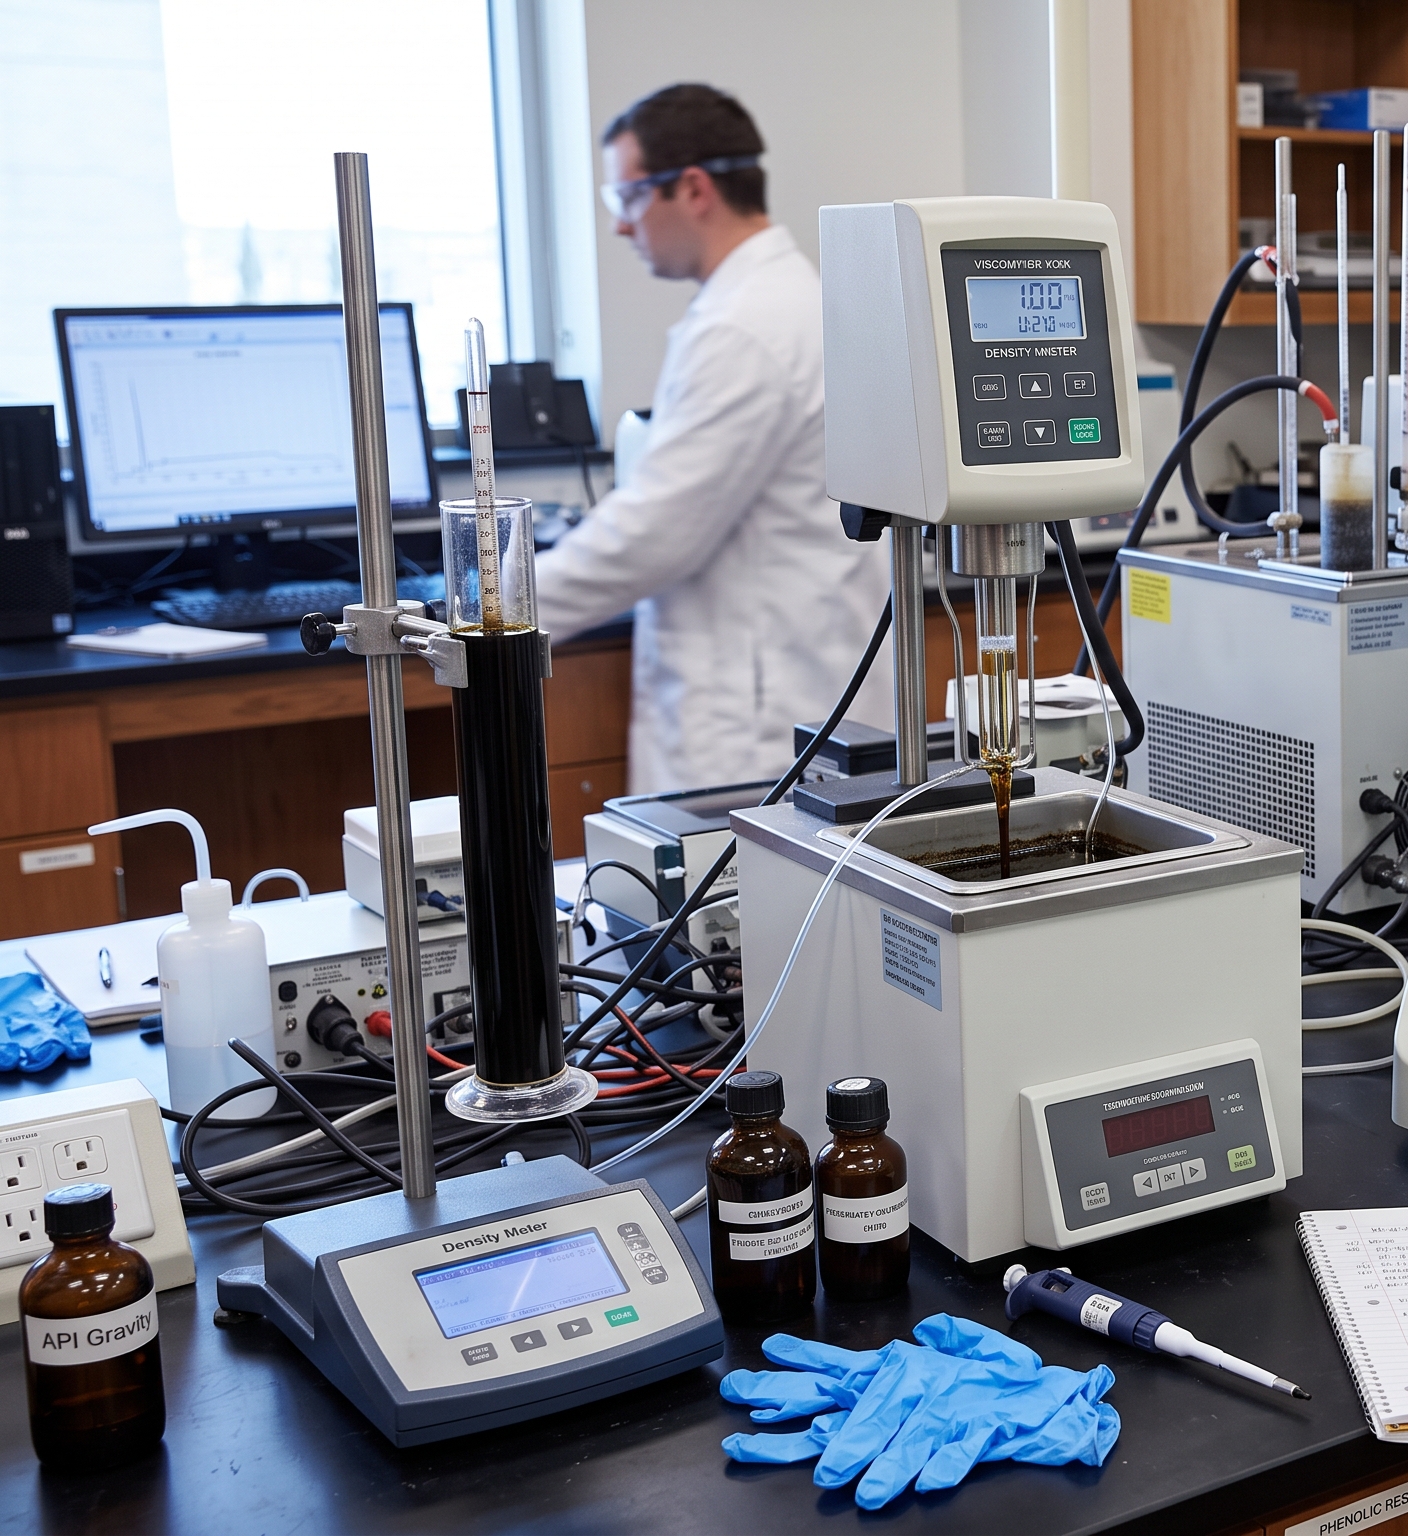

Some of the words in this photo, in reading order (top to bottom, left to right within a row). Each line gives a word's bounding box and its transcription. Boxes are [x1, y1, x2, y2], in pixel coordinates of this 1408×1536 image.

[985, 347, 1032, 358] DENSITY
[441, 1232, 500, 1254] Density
[503, 1221, 548, 1239] Meter
[42, 1331, 78, 1350] API
[87, 1310, 152, 1346] Gravity
[1319, 1503, 1382, 1536] PHENOLIC
